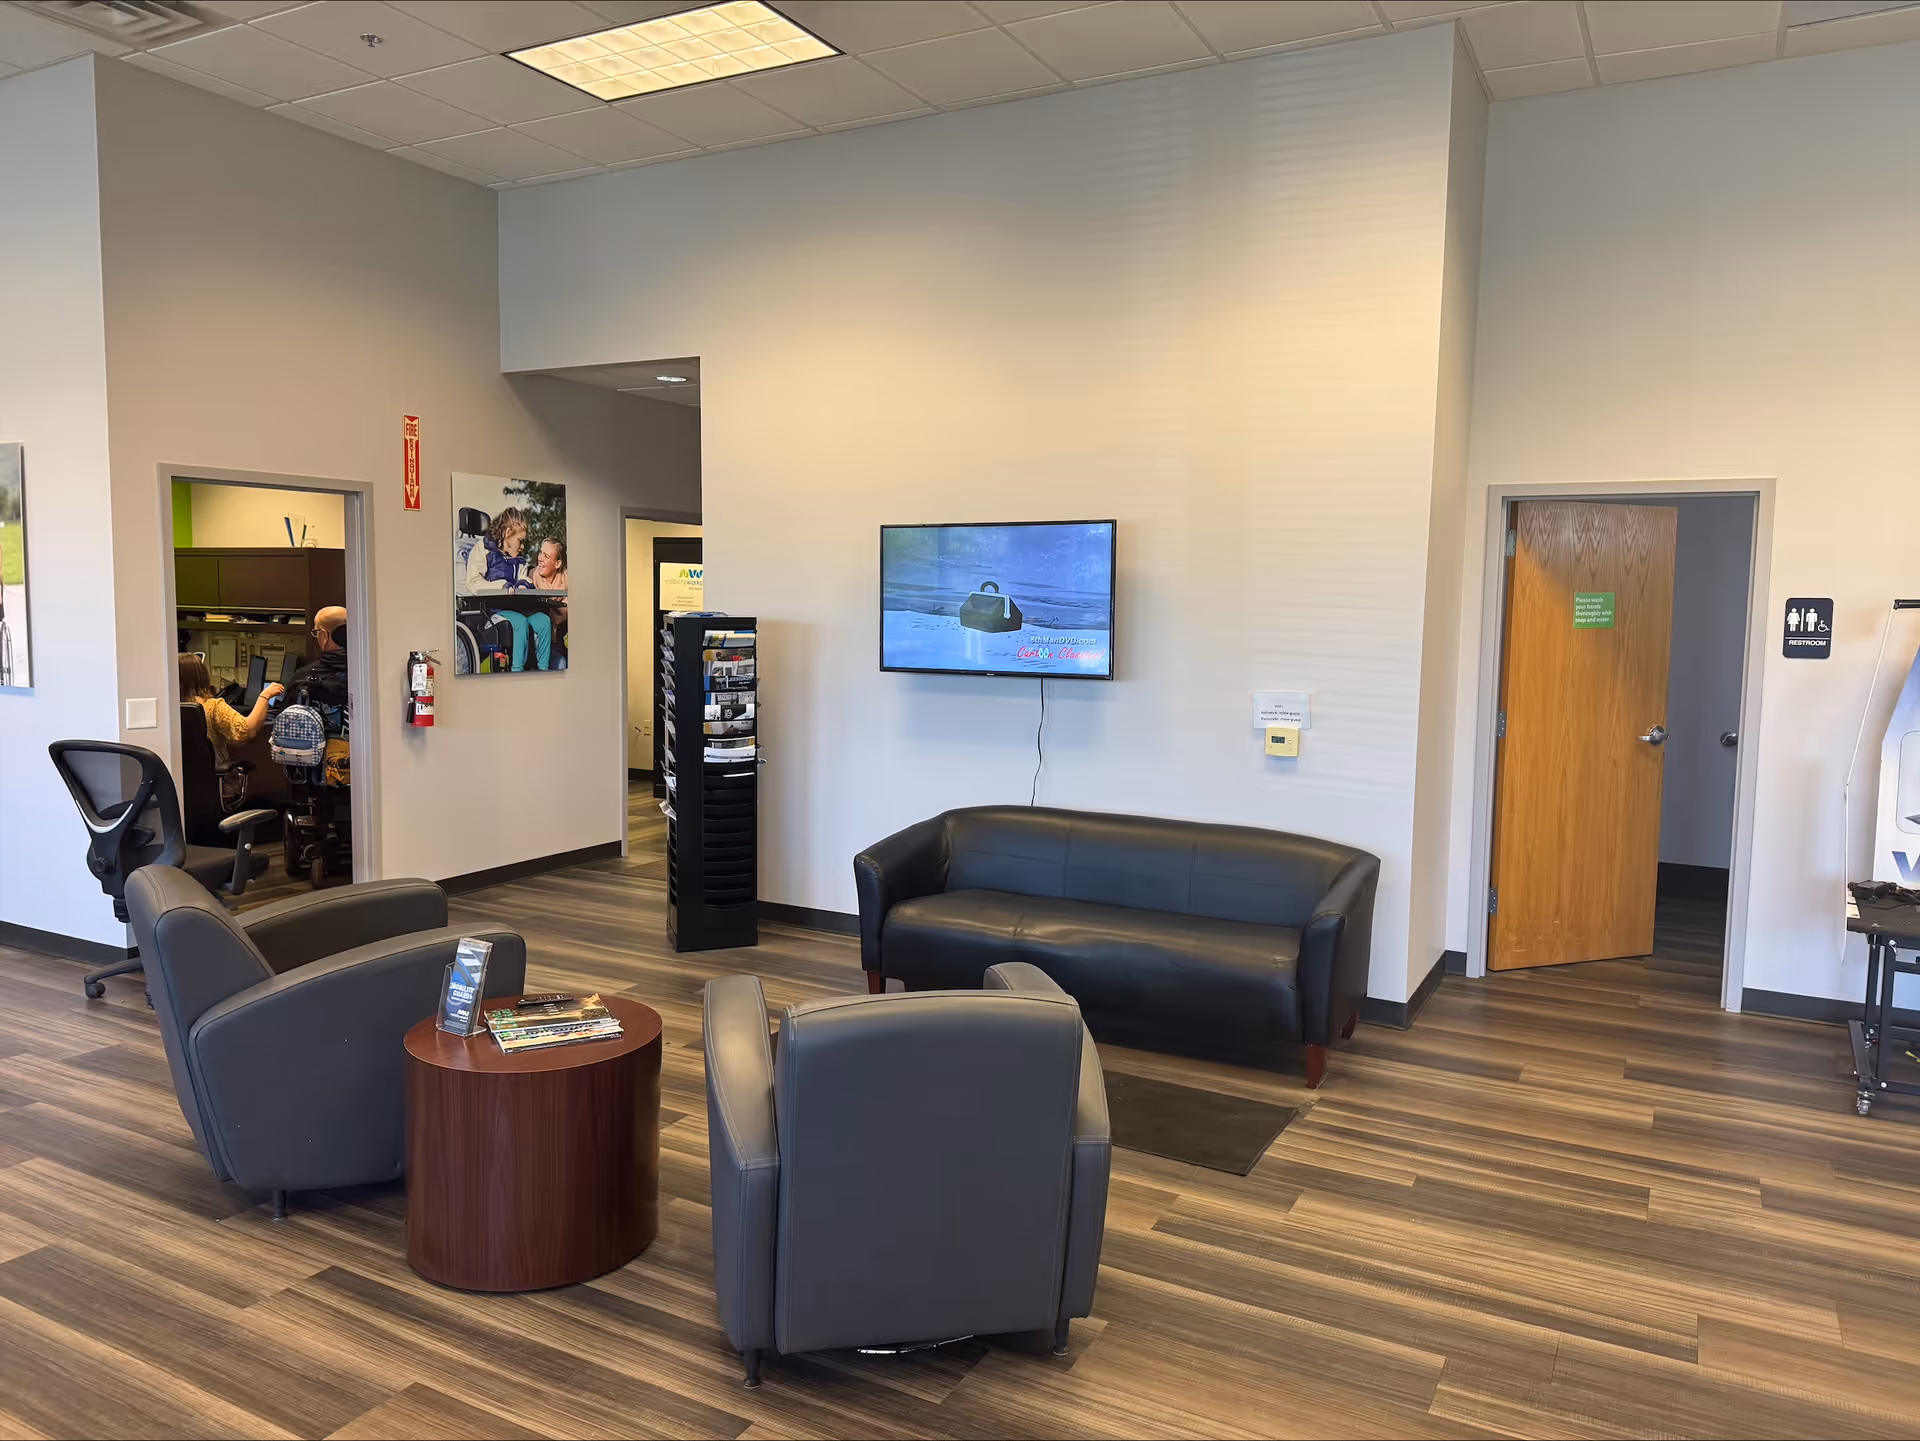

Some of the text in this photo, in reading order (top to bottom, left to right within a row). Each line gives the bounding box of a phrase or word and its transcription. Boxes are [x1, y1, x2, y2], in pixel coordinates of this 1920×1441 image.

[406, 423, 417, 436] FIRE
[1030, 635, 1097, 646] 8thManDVD.com
[1017, 645, 1054, 659] Cartoon
